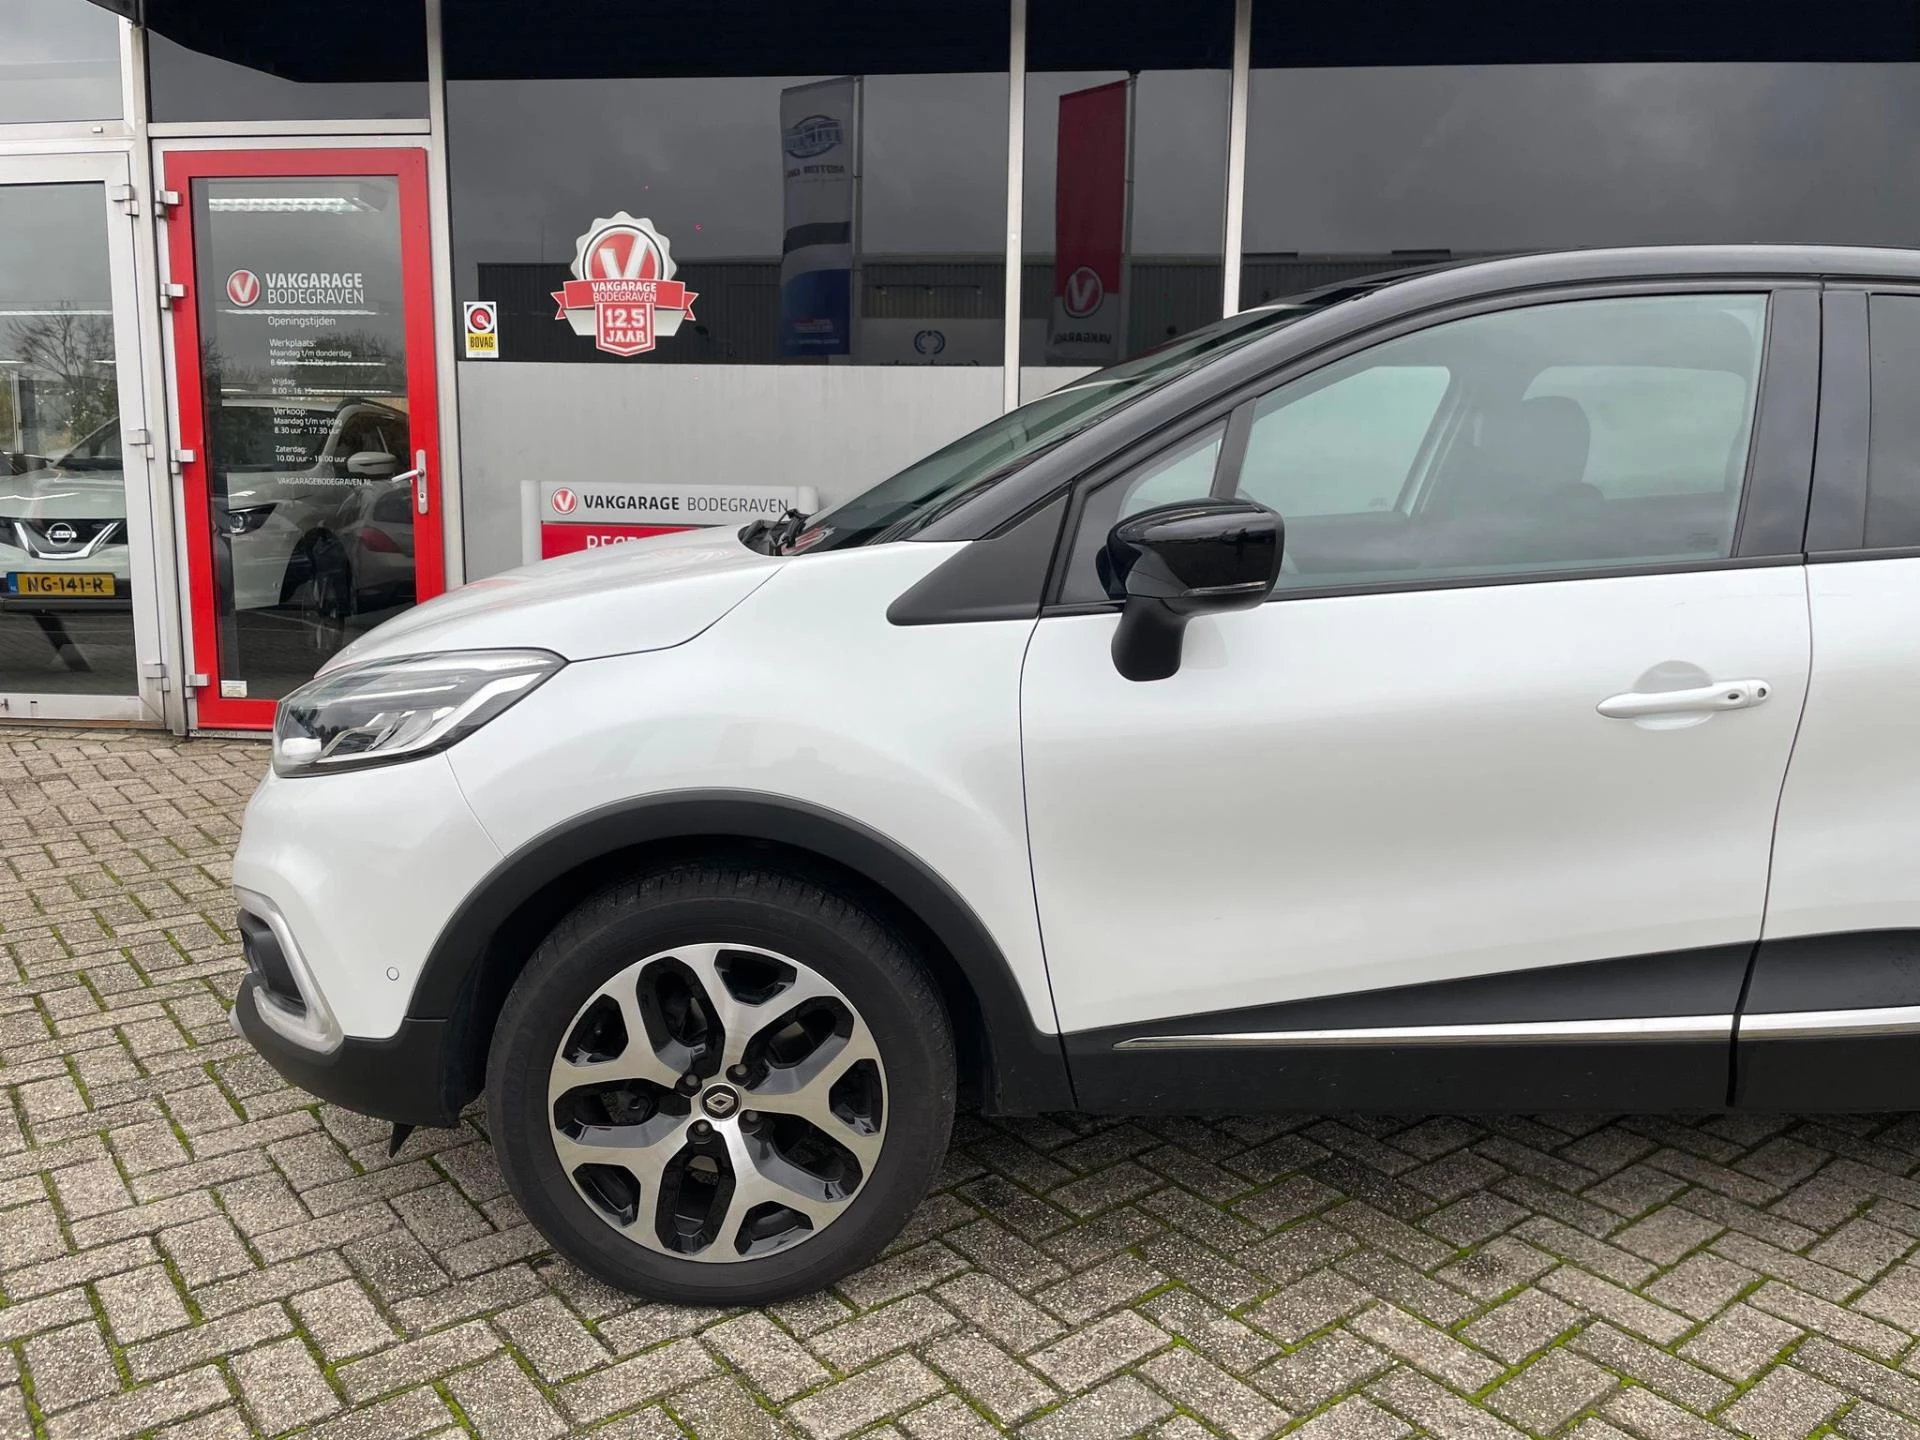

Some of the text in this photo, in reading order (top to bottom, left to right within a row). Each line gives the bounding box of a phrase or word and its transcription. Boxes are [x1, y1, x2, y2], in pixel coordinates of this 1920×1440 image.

[266, 273, 363, 288] VAKGARAGE
[591, 281, 657, 292] VAKGARAGE
[268, 289, 364, 304] BODEGRAVEN
[593, 292, 657, 302] BODEGRAVEN
[268, 316, 336, 328] Openingstijden
[605, 309, 645, 328] 12.5
[269, 338, 317, 348] Werkplaats:
[470, 336, 494, 348] BOVAG
[606, 331, 646, 343] JAAR
[270, 350, 300, 358] Maandag
[316, 350, 351, 358] donderdag
[273, 408, 307, 417] Verkoop:
[274, 418, 304, 426] Maandag
[584, 495, 788, 513] VAKGARAGE BODEGRAVEN
[27, 577, 104, 592] NG-141-R
